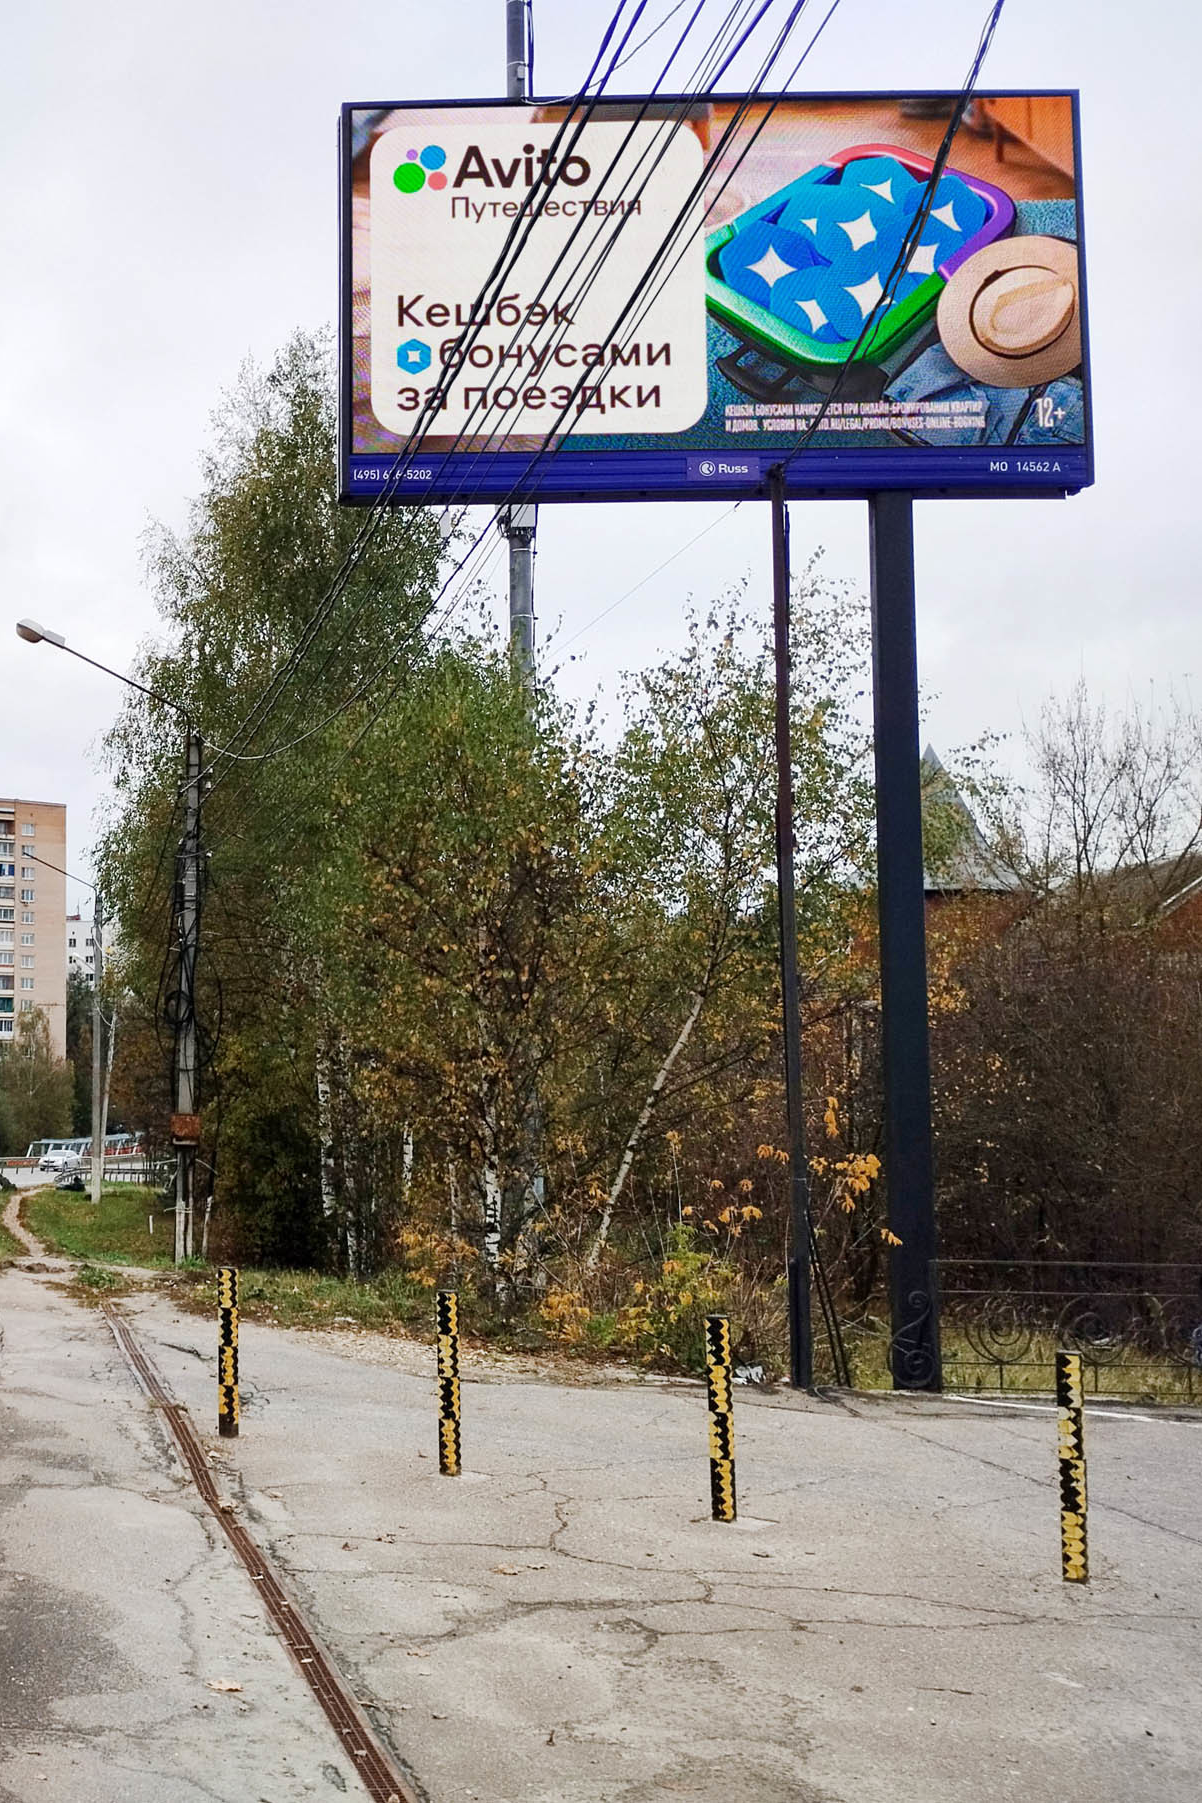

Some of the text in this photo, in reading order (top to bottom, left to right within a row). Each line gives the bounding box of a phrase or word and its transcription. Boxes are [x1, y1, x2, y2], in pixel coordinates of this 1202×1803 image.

[452, 143, 591, 188] Avito
[451, 197, 641, 224] Путешествия
[397, 293, 575, 328] Кешбэк
[439, 335, 671, 378] бонусами
[397, 384, 662, 415] за поездки
[1035, 397, 1066, 428] 12+
[353, 468, 432, 481] (495) 66-5202
[718, 463, 749, 474] Russ
[1017, 461, 1050, 472] 14562
